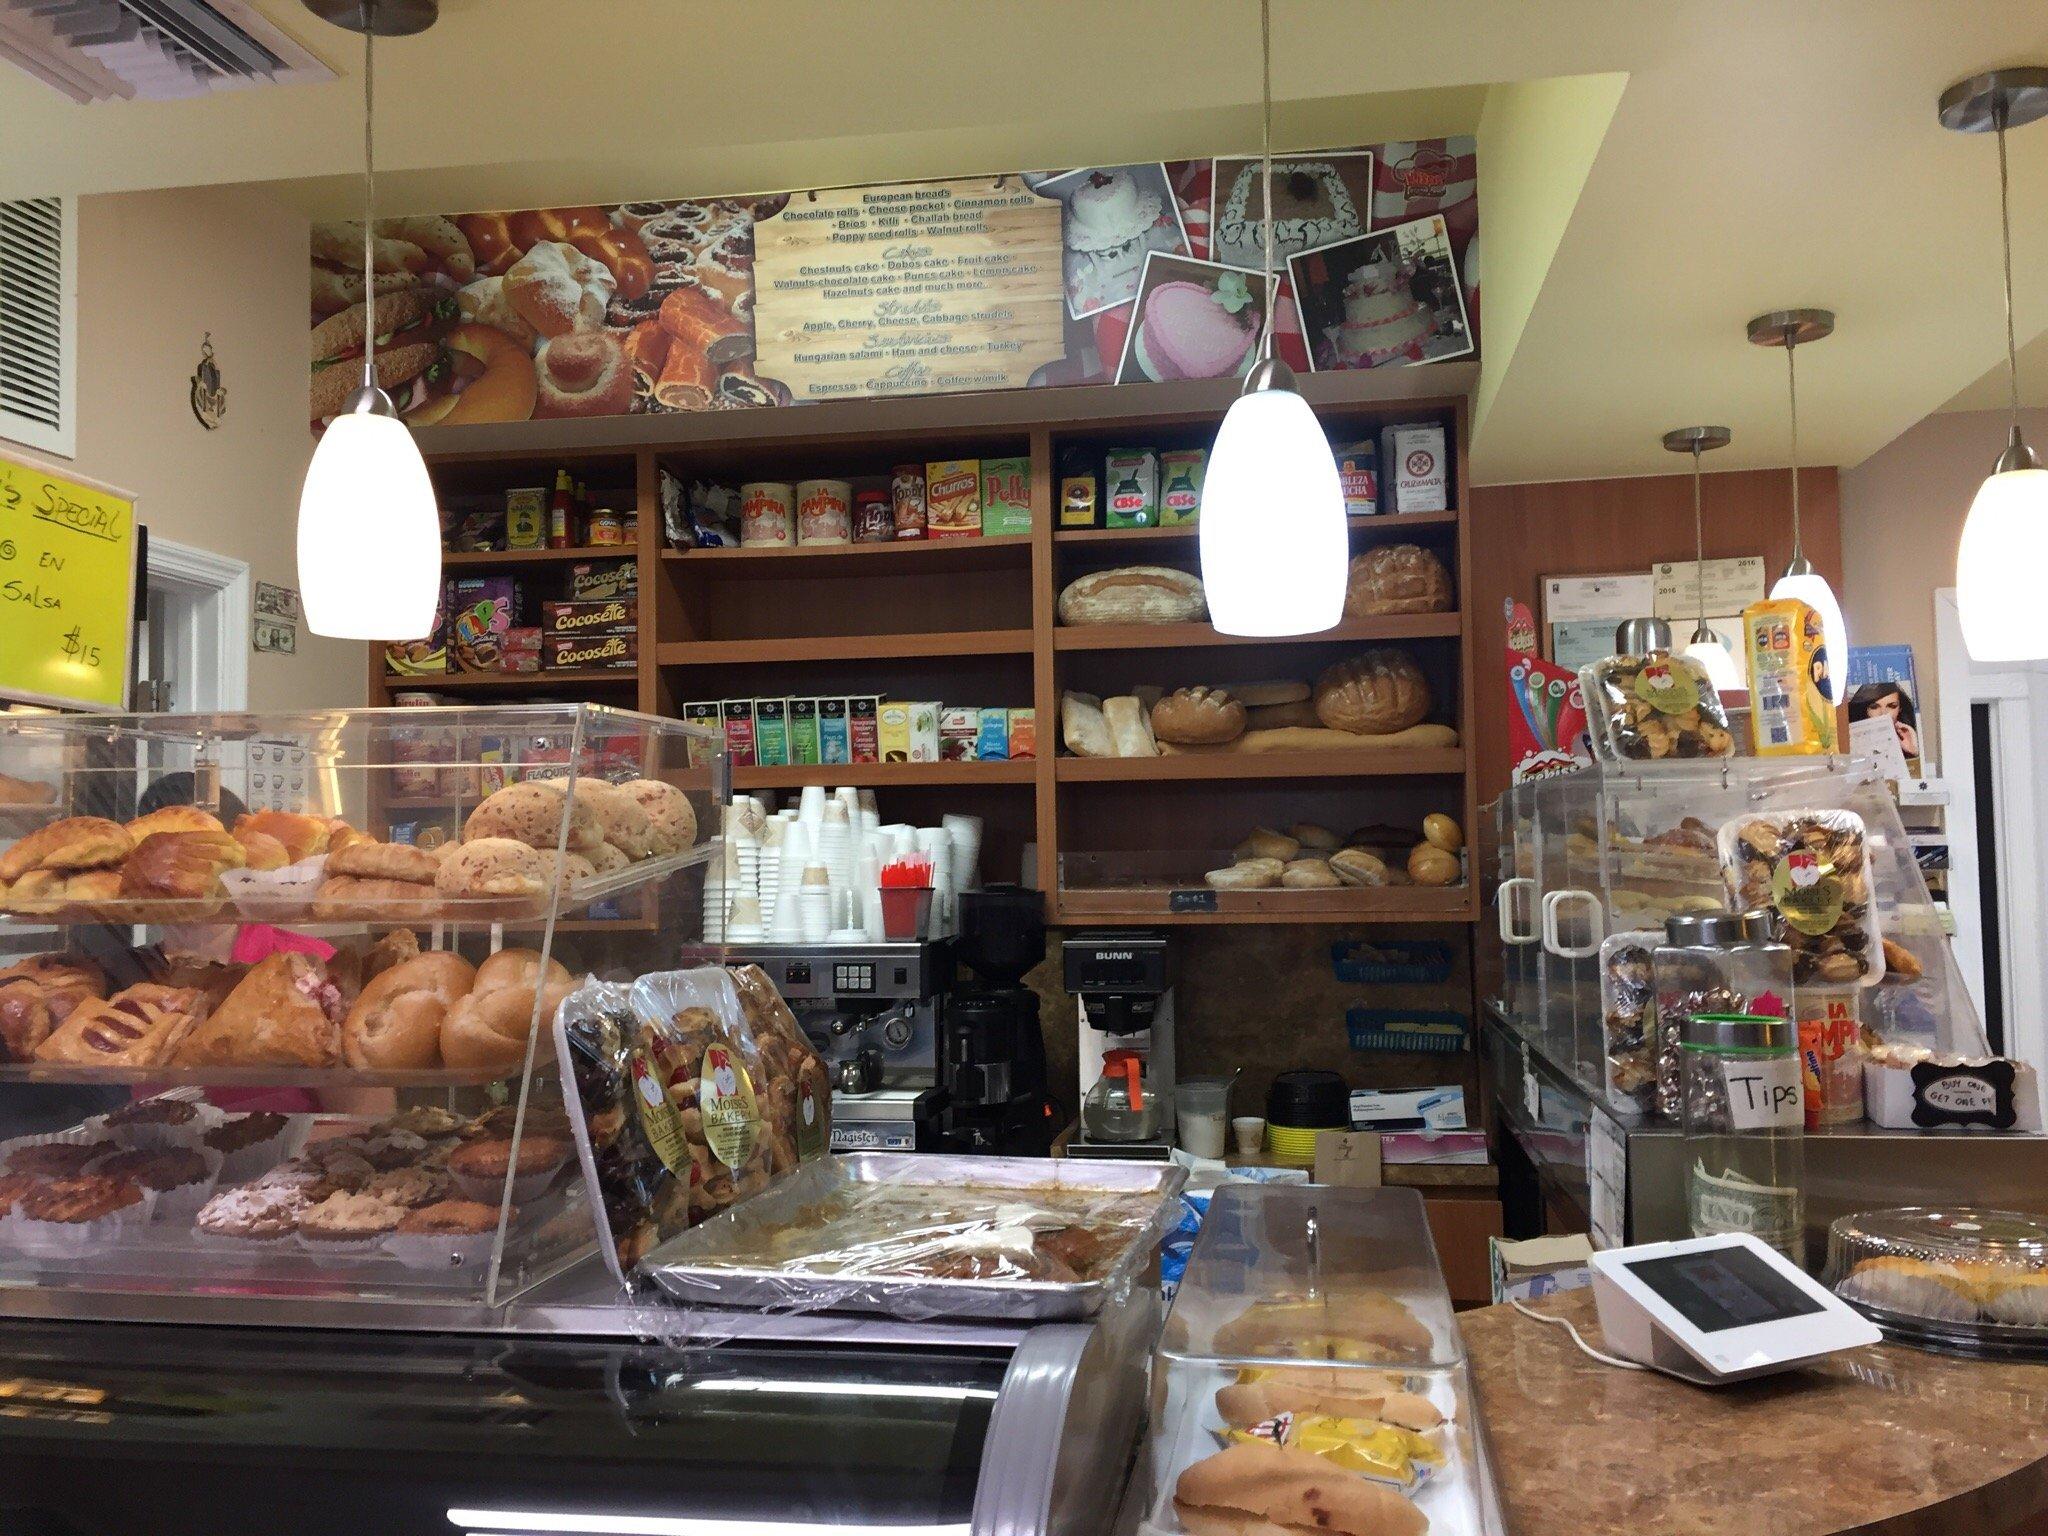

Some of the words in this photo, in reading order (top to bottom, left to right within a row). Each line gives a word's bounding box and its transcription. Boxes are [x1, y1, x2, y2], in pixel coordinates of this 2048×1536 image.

[863, 191, 913, 203] European
[915, 189, 951, 200] breads
[783, 208, 835, 220] Chocolate
[837, 207, 860, 217] rolls
[868, 204, 908, 215] Cheese
[909, 201, 945, 215] pocket
[954, 198, 1007, 208] Cinnamon
[1009, 195, 1034, 205] rolls
[953, 211, 982, 220] bread
[832, 231, 866, 243] Poppy
[868, 229, 892, 239] seed
[894, 227, 918, 238] rolls
[927, 225, 963, 236] Walnut
[965, 223, 989, 234] rolls
[800, 265, 852, 275] Chestnuts
[854, 262, 879, 273] cake
[924, 258, 949, 267] cake
[958, 255, 982, 265] Fruit
[984, 253, 1010, 263] cake
[871, 273, 896, 284] cake
[939, 268, 964, 279] cake
[823, 286, 873, 299] Hazelnuts
[876, 283, 900, 295] cake
[902, 282, 922, 293] and
[925, 280, 954, 291] much
[922, 313, 968, 324] Cabbage
[794, 351, 846, 364] Hungarian
[849, 350, 883, 360] salami
[892, 347, 916, 357] Ham
[918, 345, 937, 355] and
[940, 344, 976, 354] cheese
[987, 342, 1024, 353] Turkey
[809, 383, 857, 395] Espresso
[866, 379, 927, 391] Cappuccino
[937, 376, 973, 386] Coffee
[931, 478, 976, 497] Churros
[38, 552, 66, 571] EN
[1738, 559, 1756, 567] 2016
[1658, 587, 1677, 595] 2016
[555, 604, 626, 630] Cocosette
[60, 625, 102, 668] $15
[556, 638, 627, 664] Cocosette
[1095, 952, 1133, 960] BUNN
[1941, 1079, 1962, 1090] BUY
[1729, 1076, 1799, 1114] Tips
[1955, 1097, 1976, 1107] ONE
